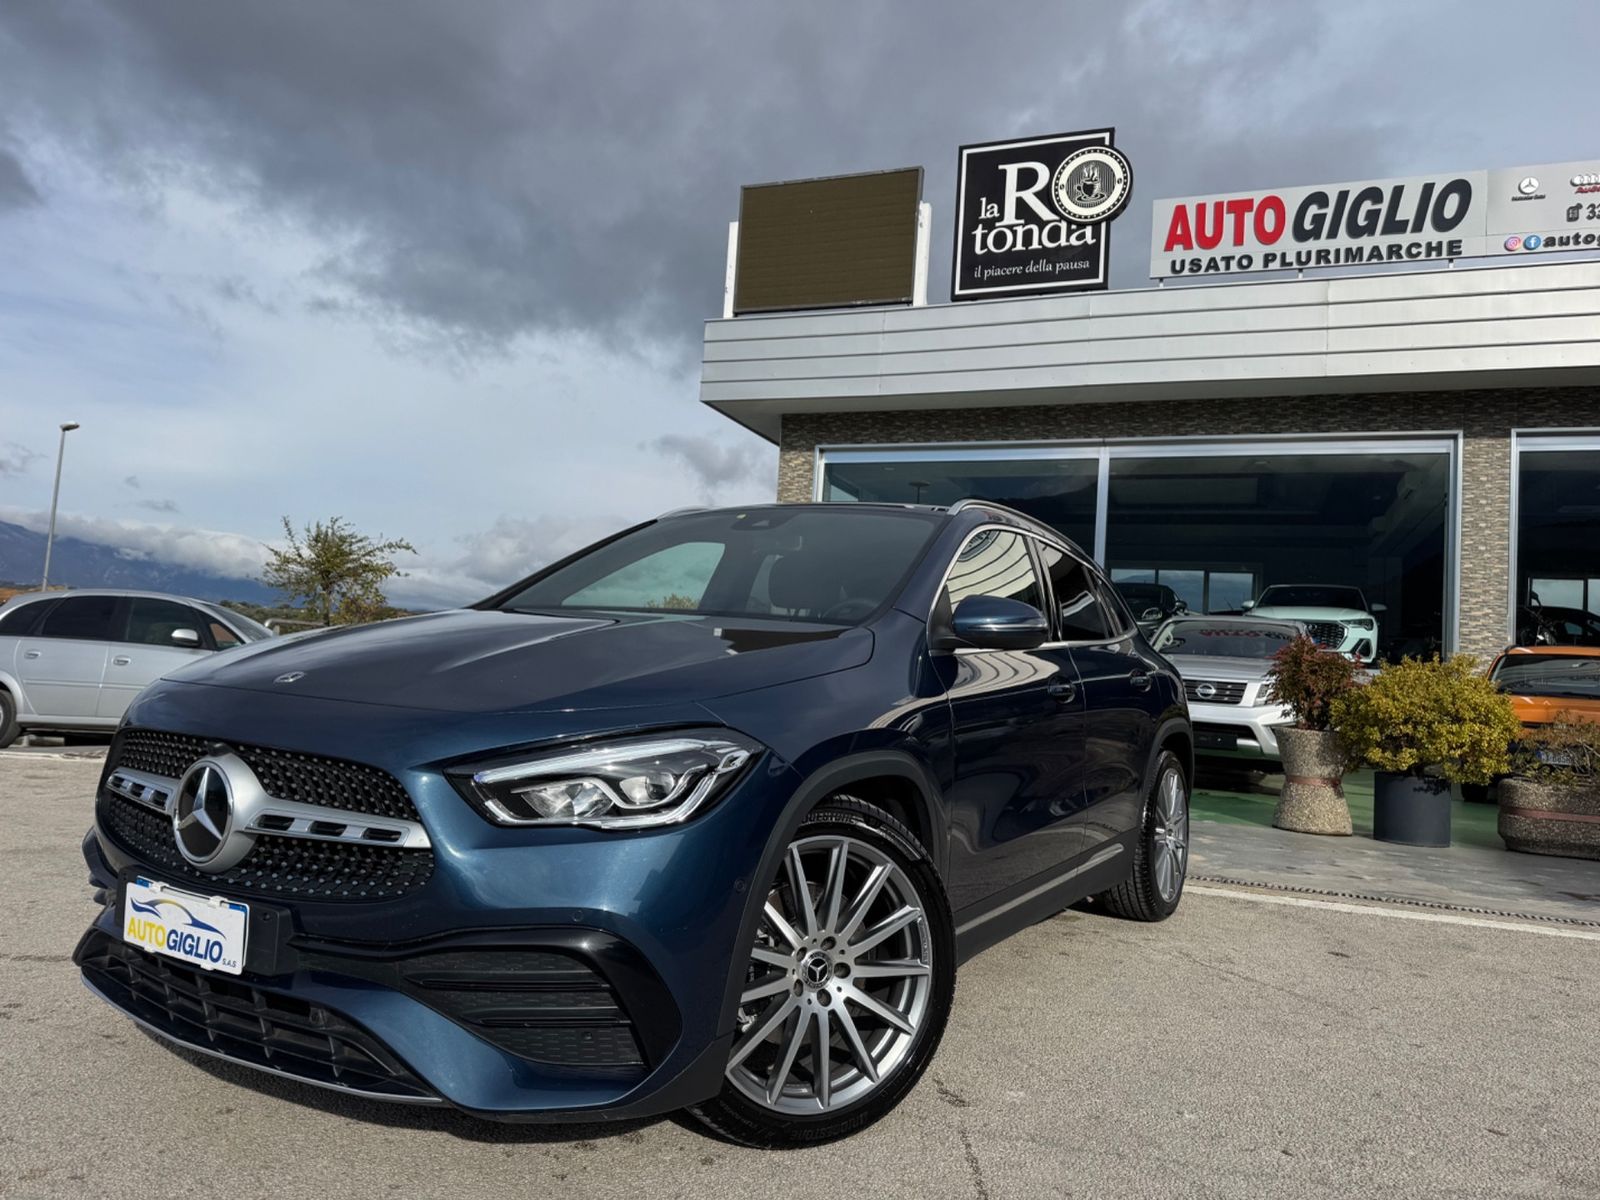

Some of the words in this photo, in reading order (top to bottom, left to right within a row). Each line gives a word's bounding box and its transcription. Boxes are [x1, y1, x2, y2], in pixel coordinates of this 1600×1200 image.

[979, 197, 1000, 219] la
[1164, 195, 1287, 252] AUTO
[1292, 178, 1472, 243] GIGLIO
[971, 219, 1097, 255] tonda
[974, 265, 982, 278] il
[984, 265, 1023, 280] piacere
[1025, 259, 1052, 273] della
[1055, 260, 1090, 274] pausa
[1170, 254, 1254, 275] USATO
[1262, 239, 1463, 269] PLURIMARCHE
